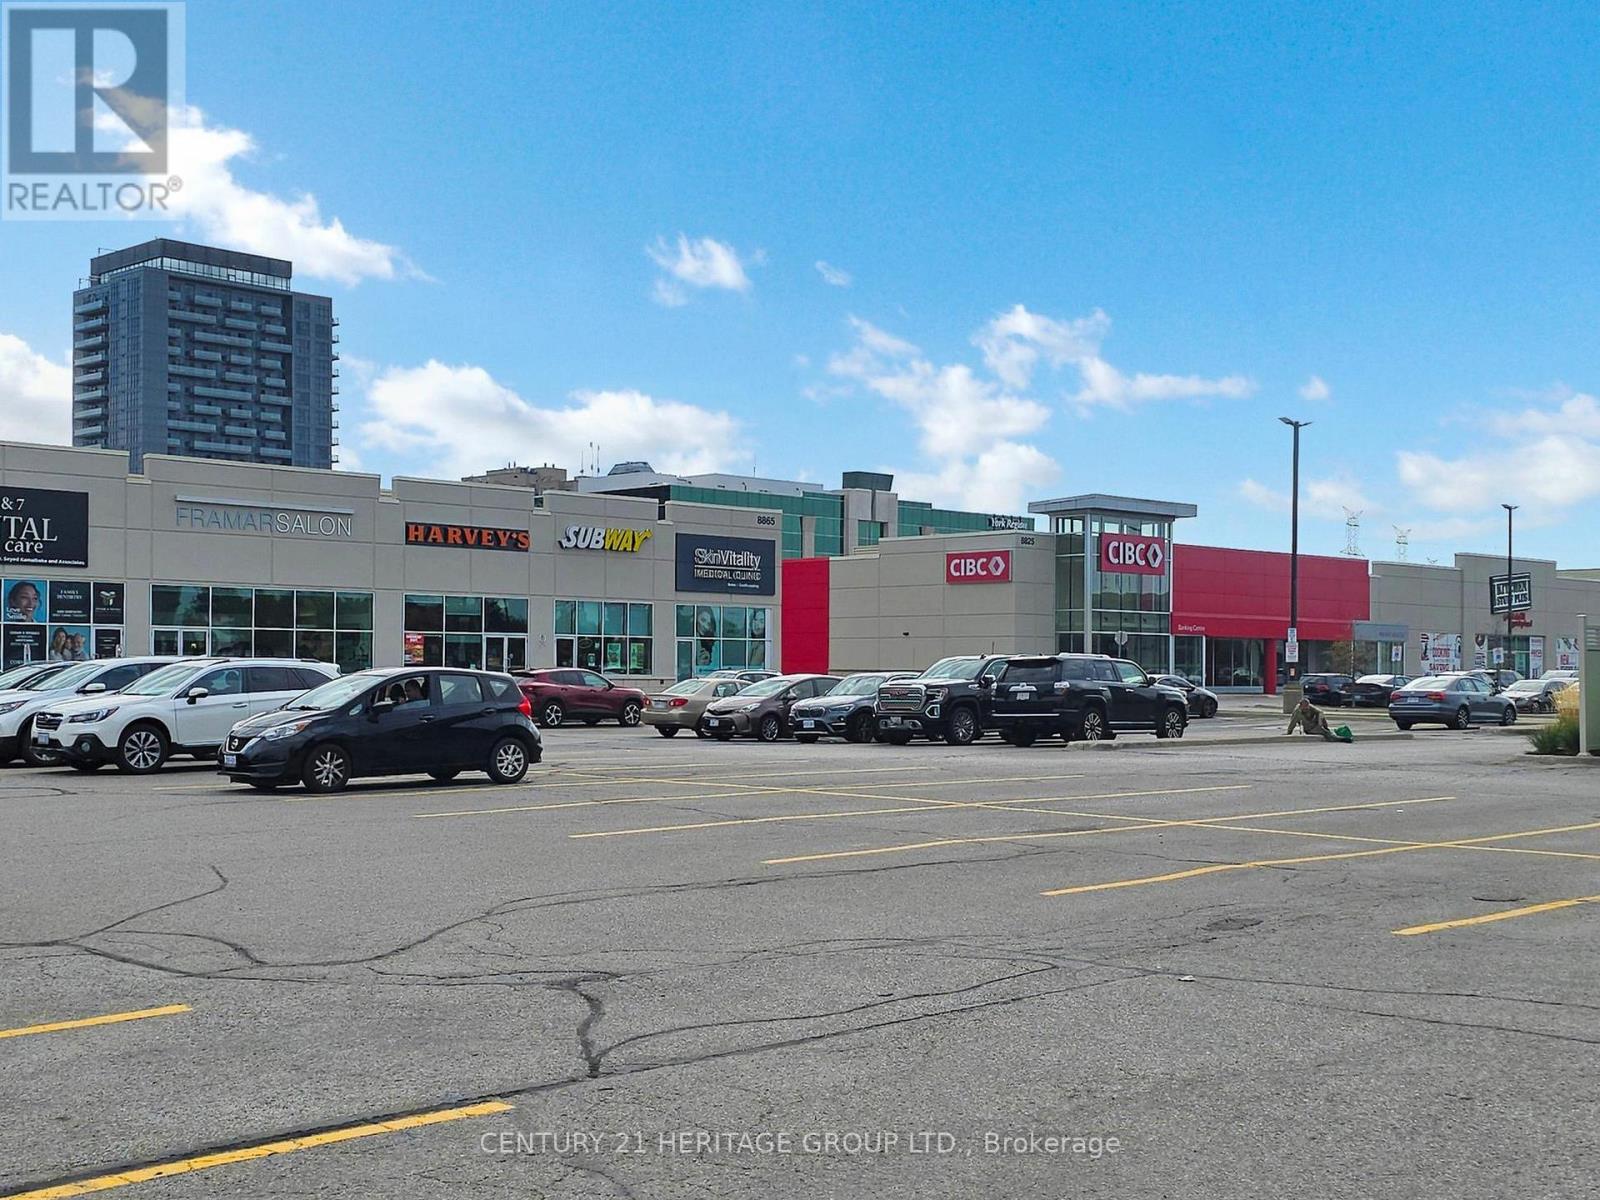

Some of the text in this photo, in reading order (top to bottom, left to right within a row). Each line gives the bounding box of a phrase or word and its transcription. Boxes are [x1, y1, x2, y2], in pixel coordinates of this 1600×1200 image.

[1, 496, 25, 510] & 7
[0, 515, 58, 541] TAL
[175, 506, 352, 537] FRAMARSALON
[757, 515, 776, 526] 8865
[4, 539, 44, 554] care
[407, 524, 530, 549] HARVEY'S
[558, 526, 653, 552] SUBWAY
[1108, 541, 1146, 566] CIBC
[950, 557, 988, 577] CIBC
